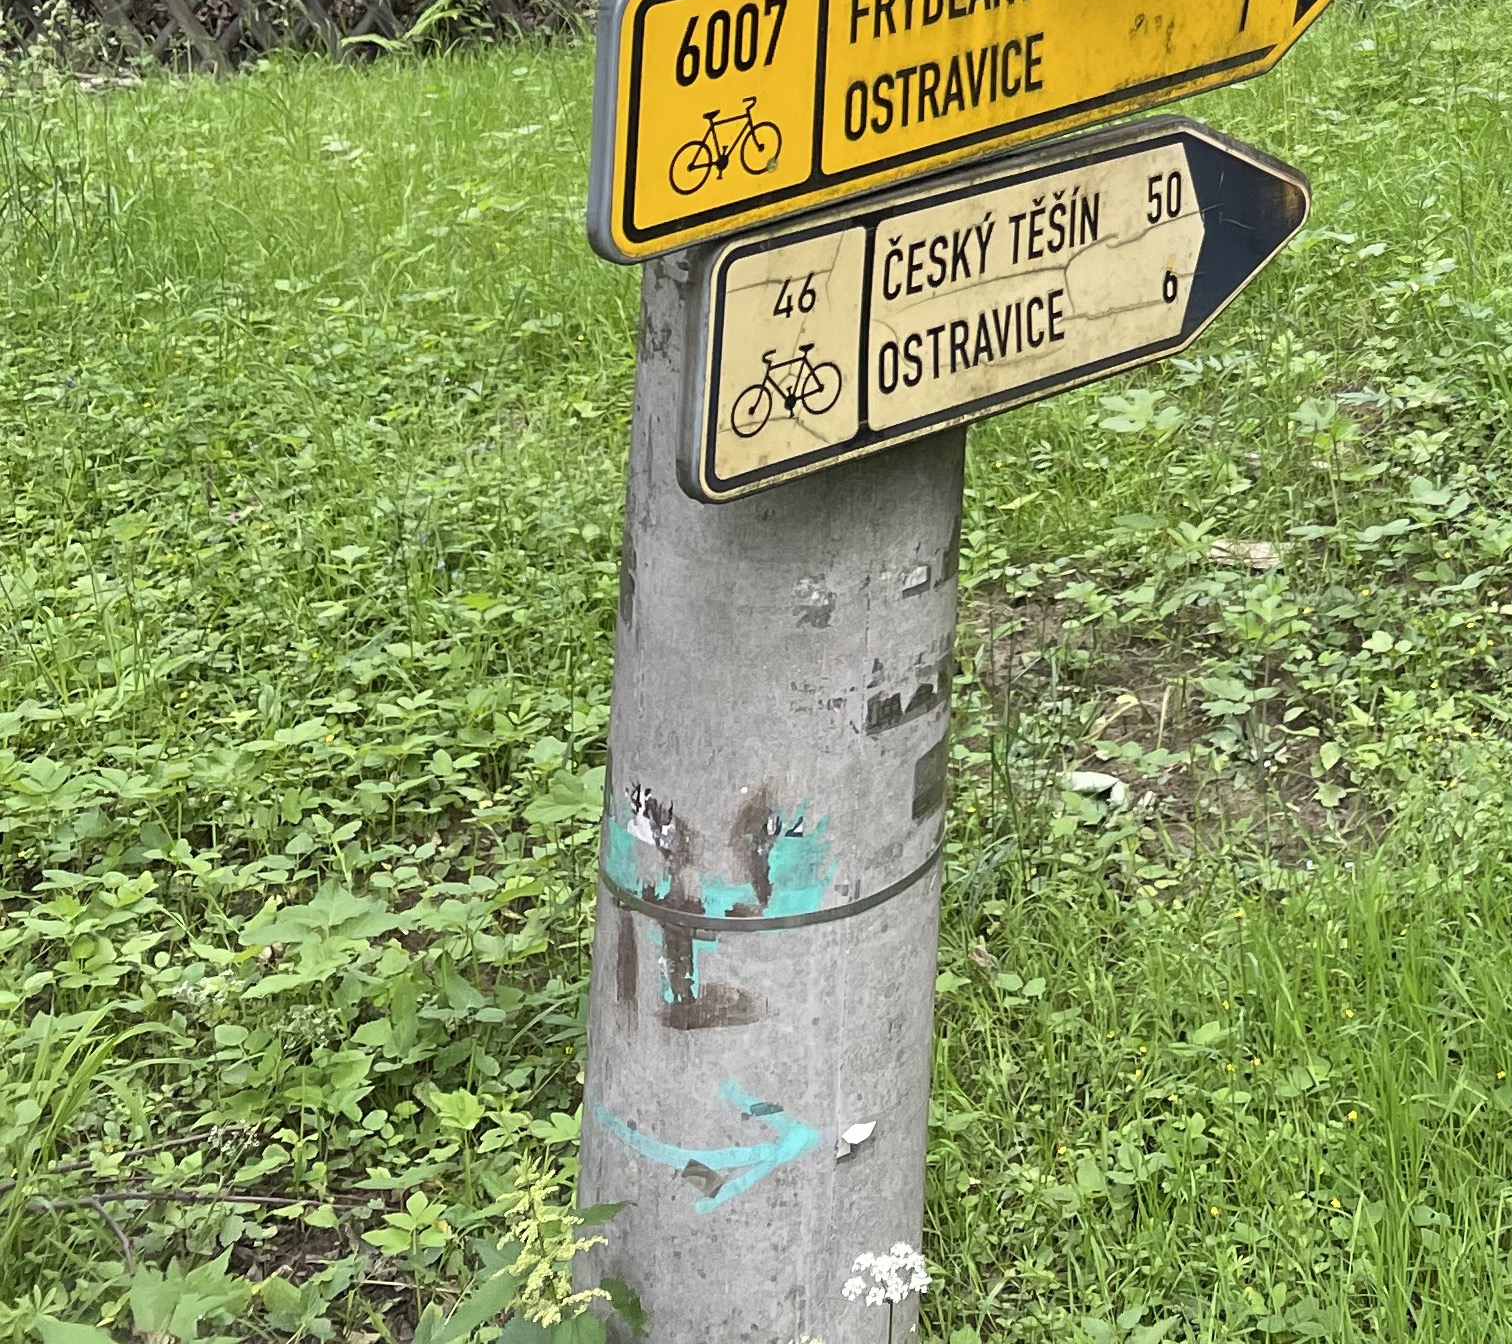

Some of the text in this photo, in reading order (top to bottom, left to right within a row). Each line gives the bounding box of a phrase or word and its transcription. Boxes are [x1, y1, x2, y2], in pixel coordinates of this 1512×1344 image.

[845, 32, 1044, 143] OSTRAVICE
[883, 171, 1181, 300] ČESKÝ TĚŠÍN 50
[773, 272, 817, 318] 46
[879, 270, 1177, 394] OSTRAVICE 6
